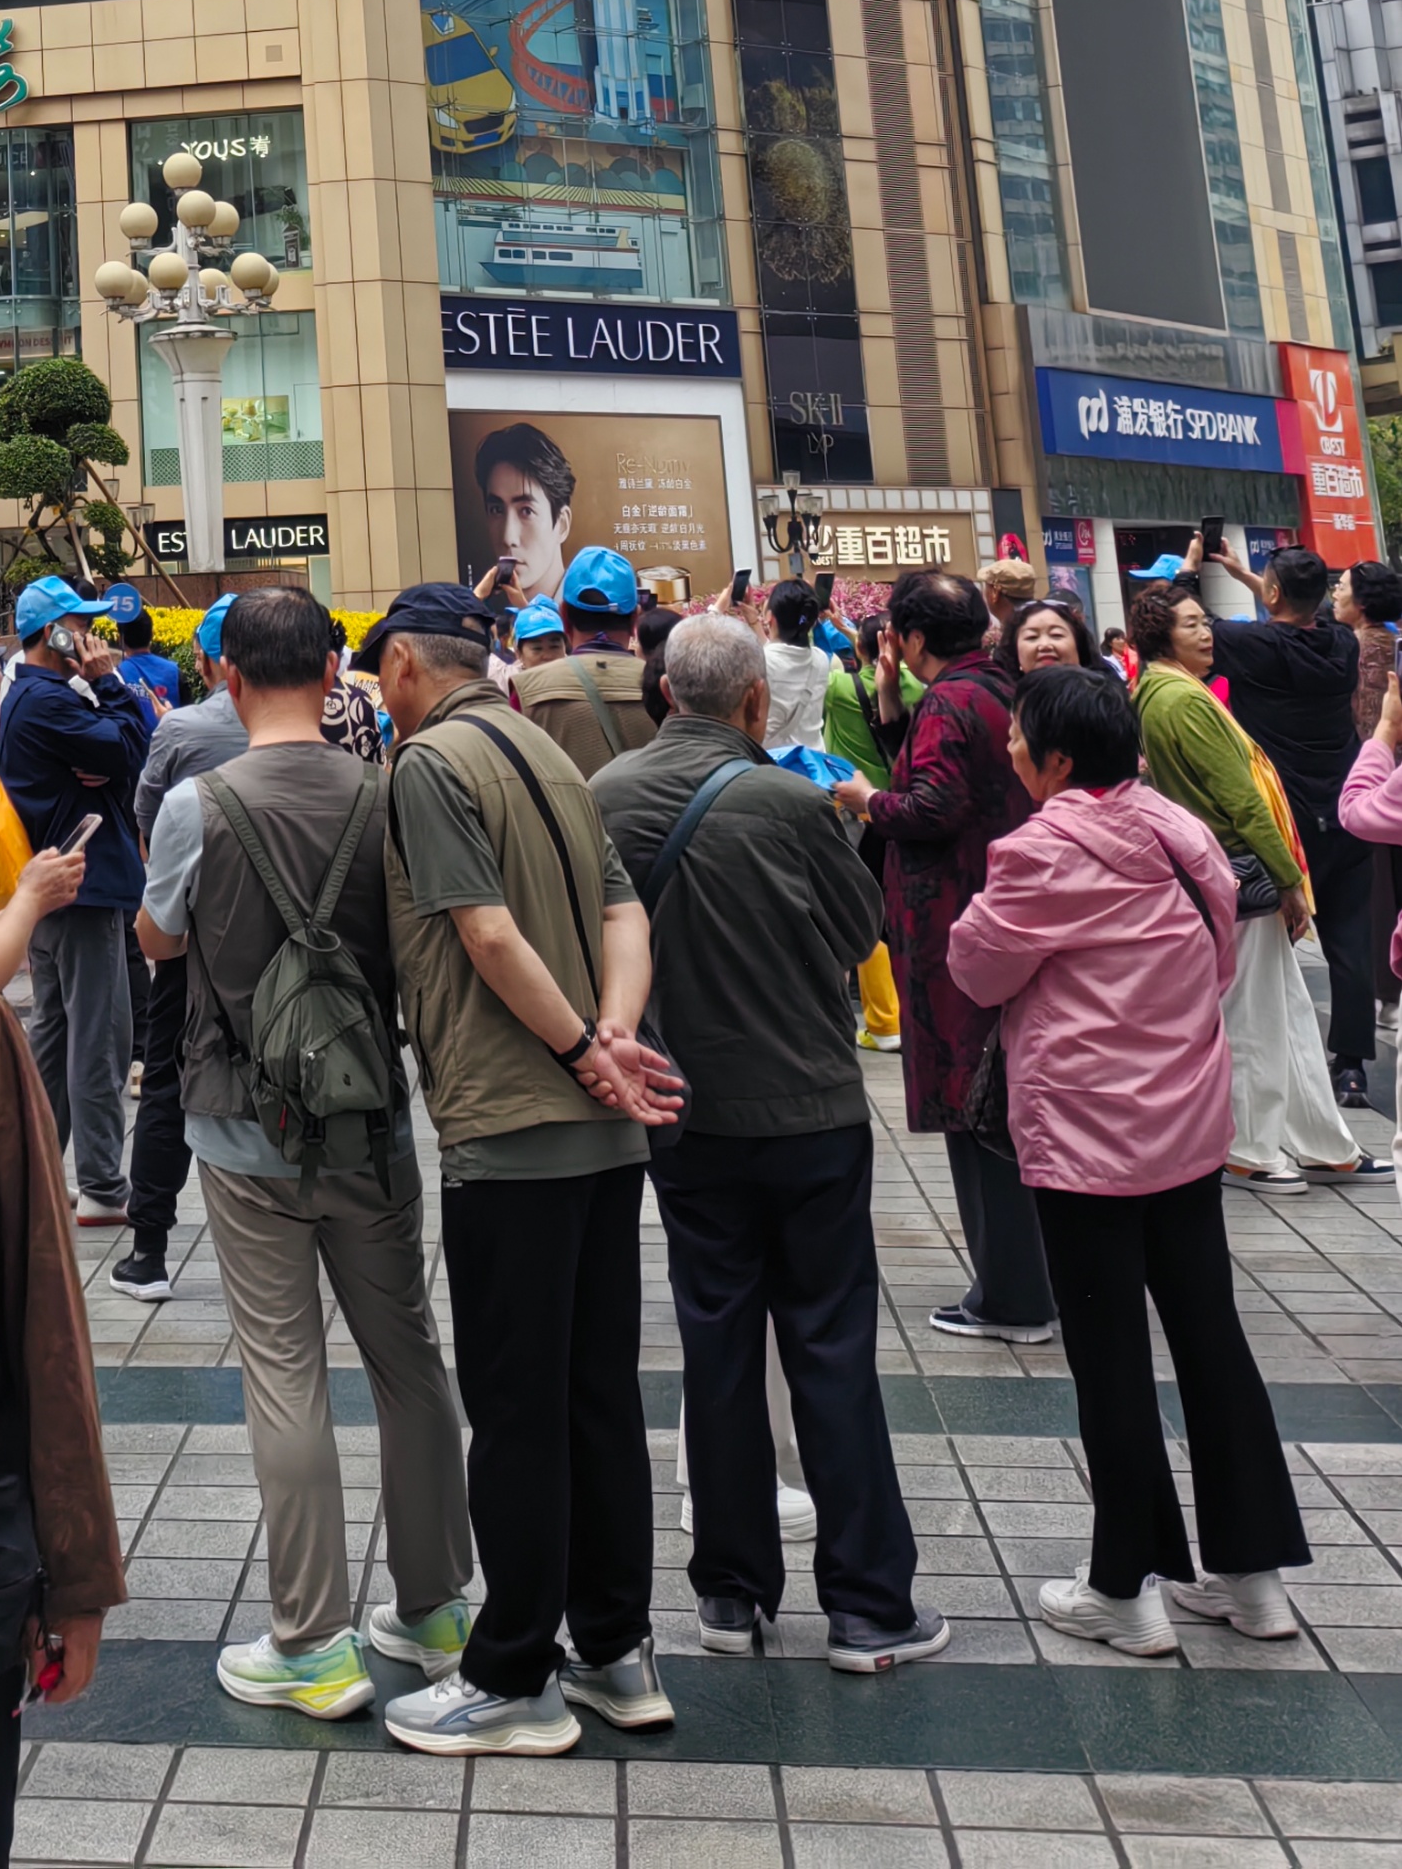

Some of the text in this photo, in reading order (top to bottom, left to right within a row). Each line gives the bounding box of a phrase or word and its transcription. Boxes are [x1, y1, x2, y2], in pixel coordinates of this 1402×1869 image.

[567, 317, 724, 364] LAUDER
[1113, 395, 1184, 440] 浦发银行
[1311, 463, 1364, 499] 重百超市
[231, 525, 325, 549] LAUDER
[835, 525, 951, 565] 重百超市
